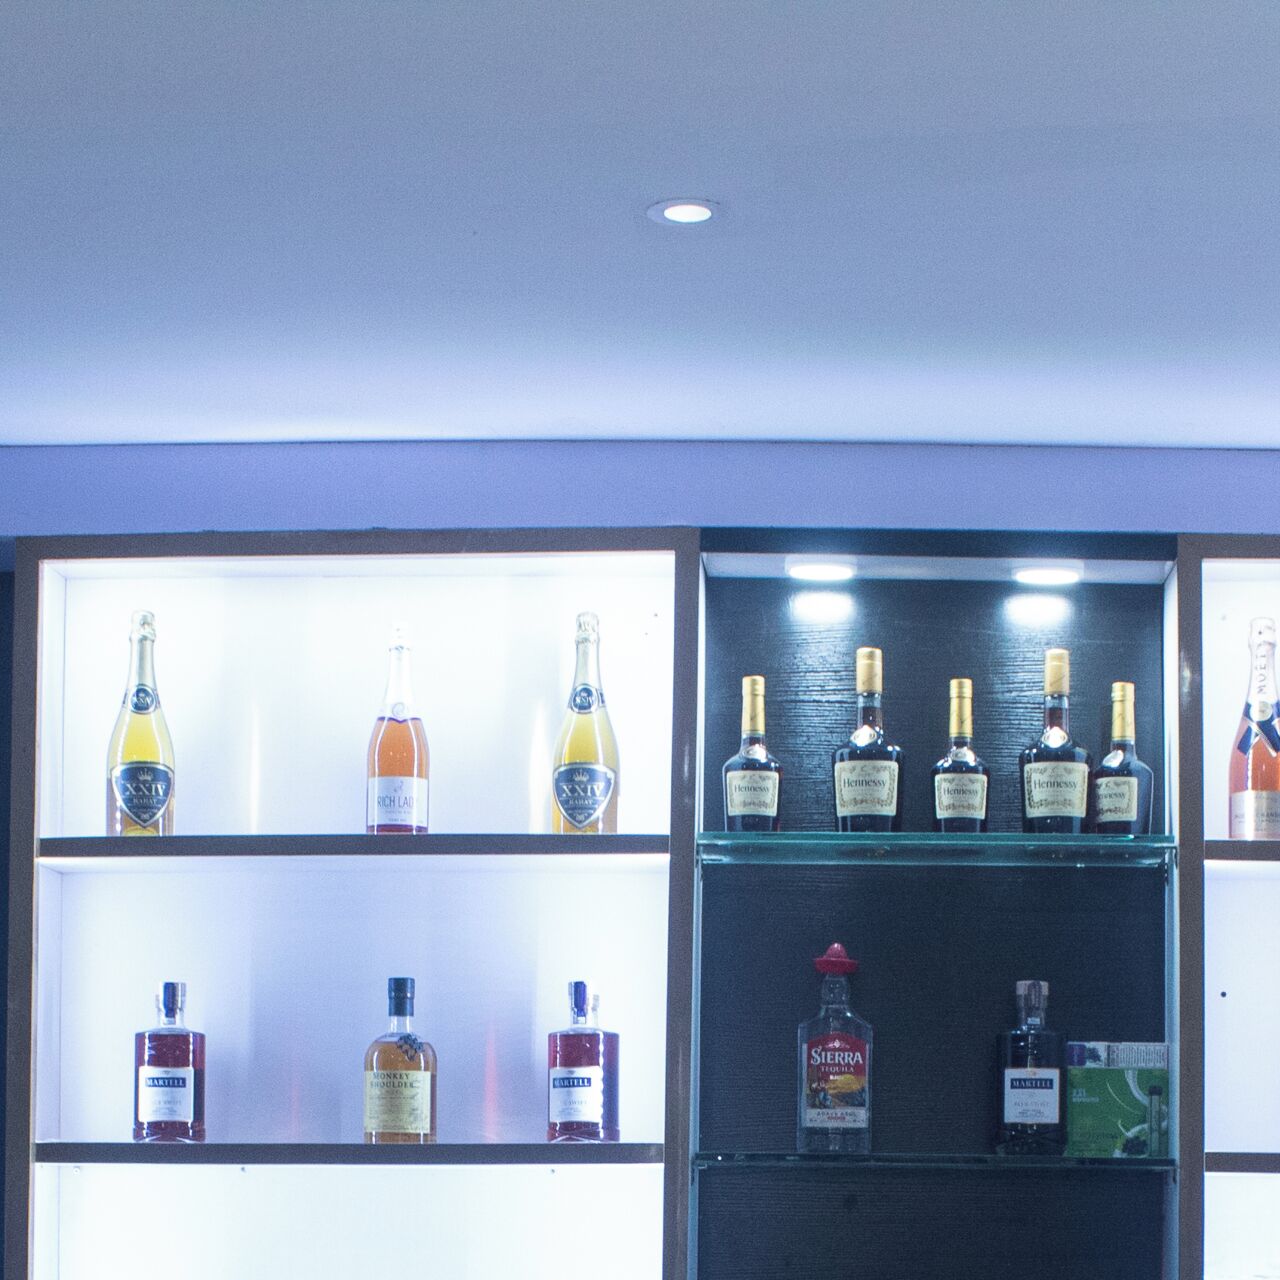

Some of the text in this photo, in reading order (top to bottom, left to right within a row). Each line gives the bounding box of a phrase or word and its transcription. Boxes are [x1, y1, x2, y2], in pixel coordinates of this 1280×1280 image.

[734, 784, 770, 793] Hennessy
[843, 778, 887, 789] Hennessy
[1034, 779, 1077, 790] Hennessy
[126, 784, 167, 796] XXIV
[562, 784, 604, 797] XXIV
[943, 786, 978, 796] Hennessy
[1096, 791, 1126, 800] ennessy
[377, 796, 416, 808] RICH LAD
[811, 1046, 863, 1066] SIERRA
[373, 1072, 410, 1080] MONKEY
[145, 1078, 185, 1086] MARTELL
[554, 1078, 590, 1086] MARTELL
